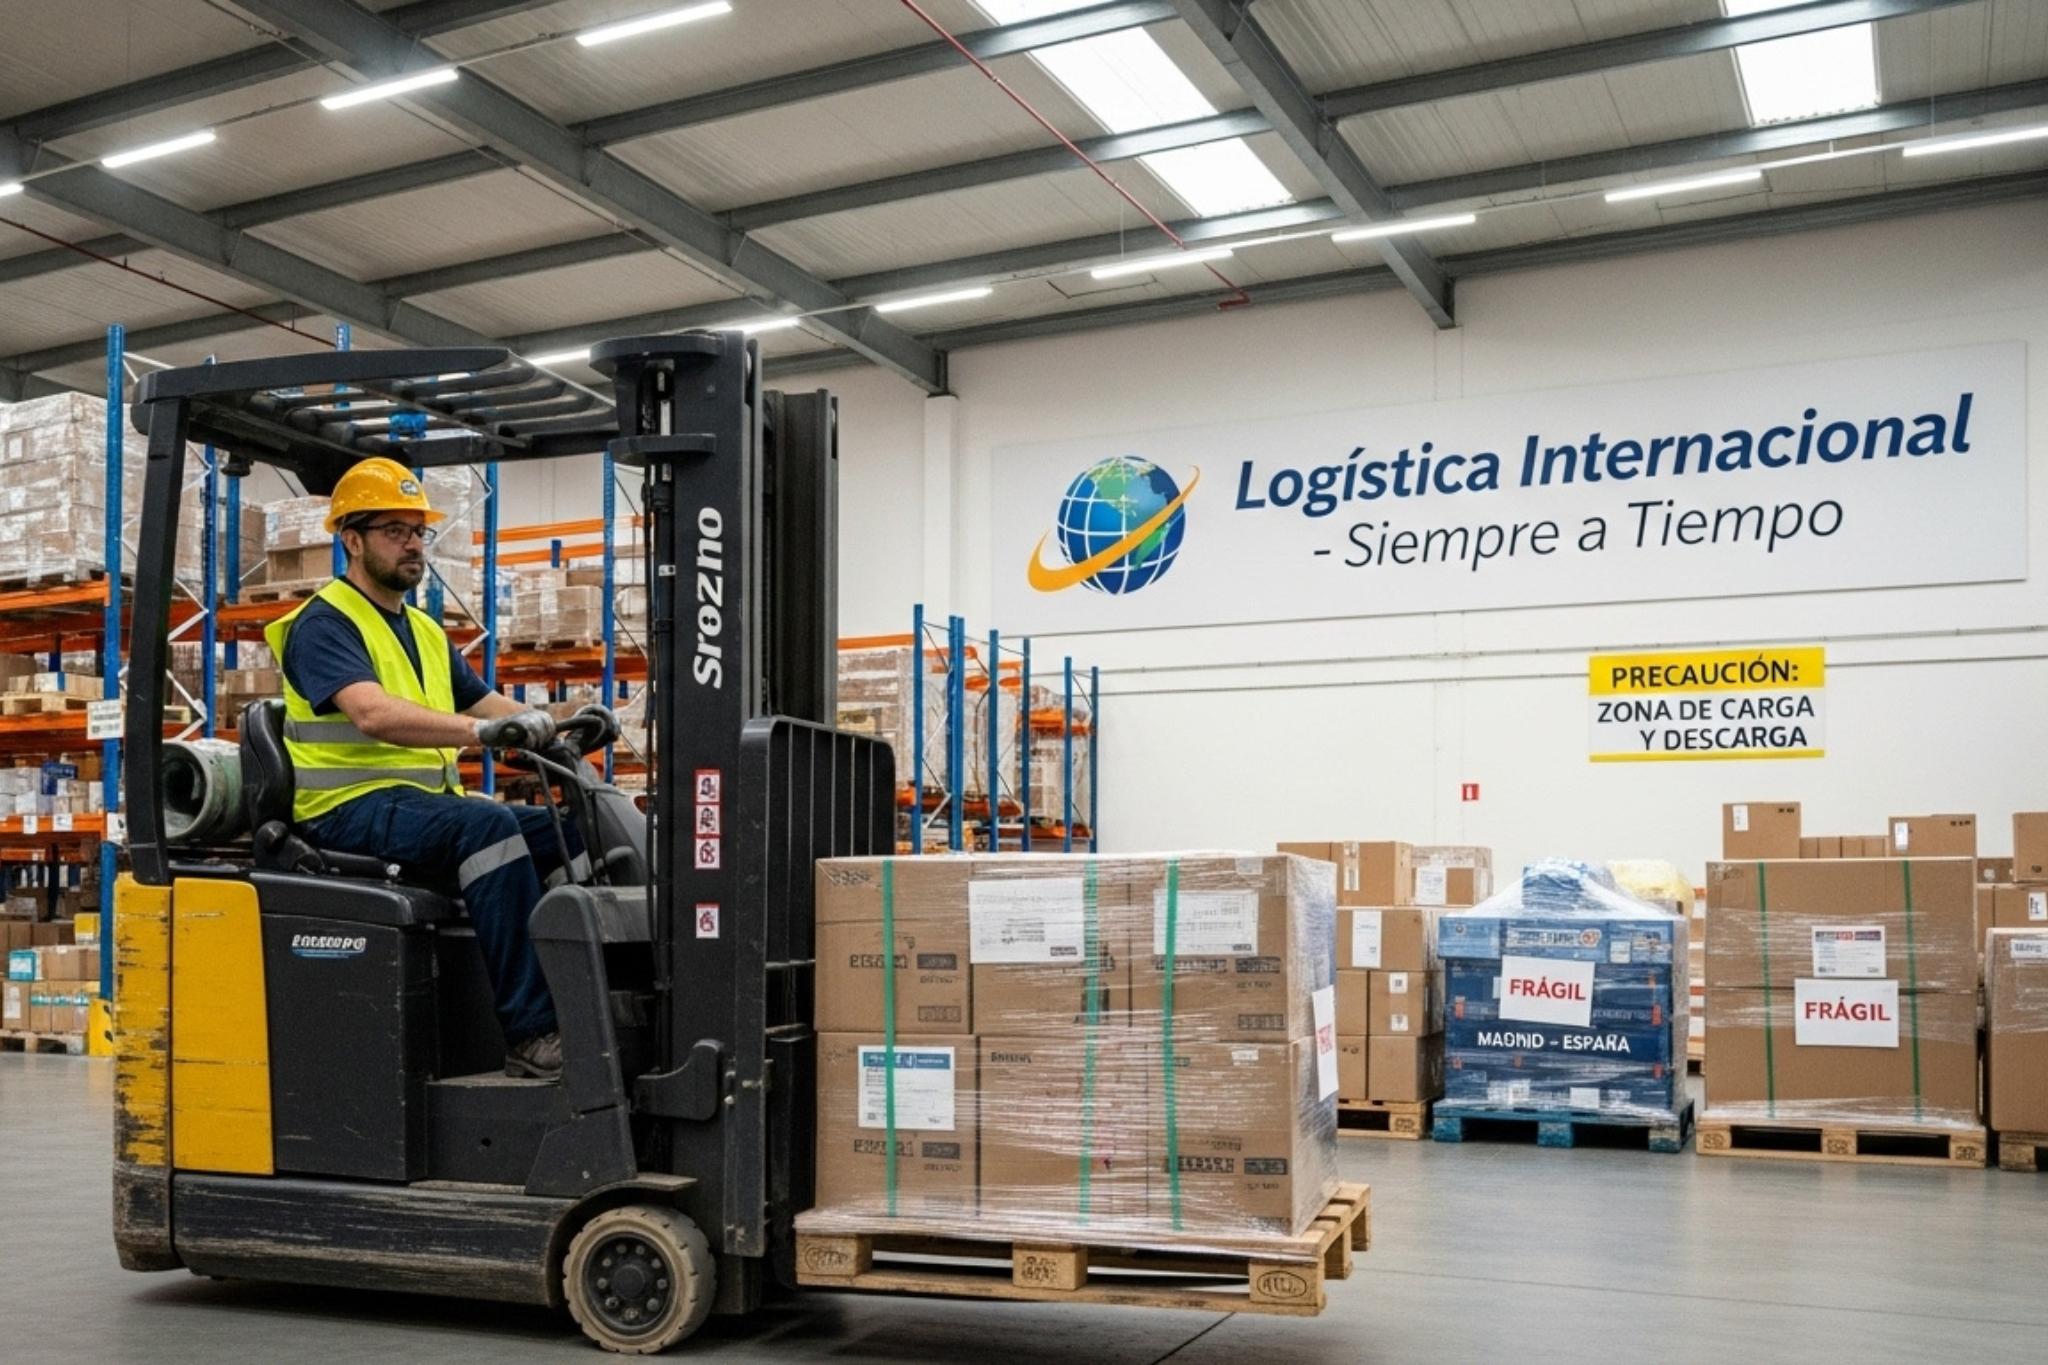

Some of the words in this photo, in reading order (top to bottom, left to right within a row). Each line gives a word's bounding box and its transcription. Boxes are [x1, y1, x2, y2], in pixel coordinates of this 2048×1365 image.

[1236, 441, 1500, 518] Logística
[1520, 393, 1974, 487] Internacional
[1344, 521, 1559, 572] Siempre
[1578, 517, 1606, 552] a
[1628, 499, 1843, 553] Tiempo
[1612, 654, 1799, 688] PRECAUCIÓN:
[1597, 699, 1673, 723] ZONA
[1679, 699, 1712, 721] DE
[1720, 695, 1815, 720] CARGA
[1640, 729, 1656, 751] Y
[1664, 726, 1808, 751] DESCARGA
[1510, 976, 1586, 1001] FRÁGIL
[1805, 996, 1891, 1021] FRÁGIL
